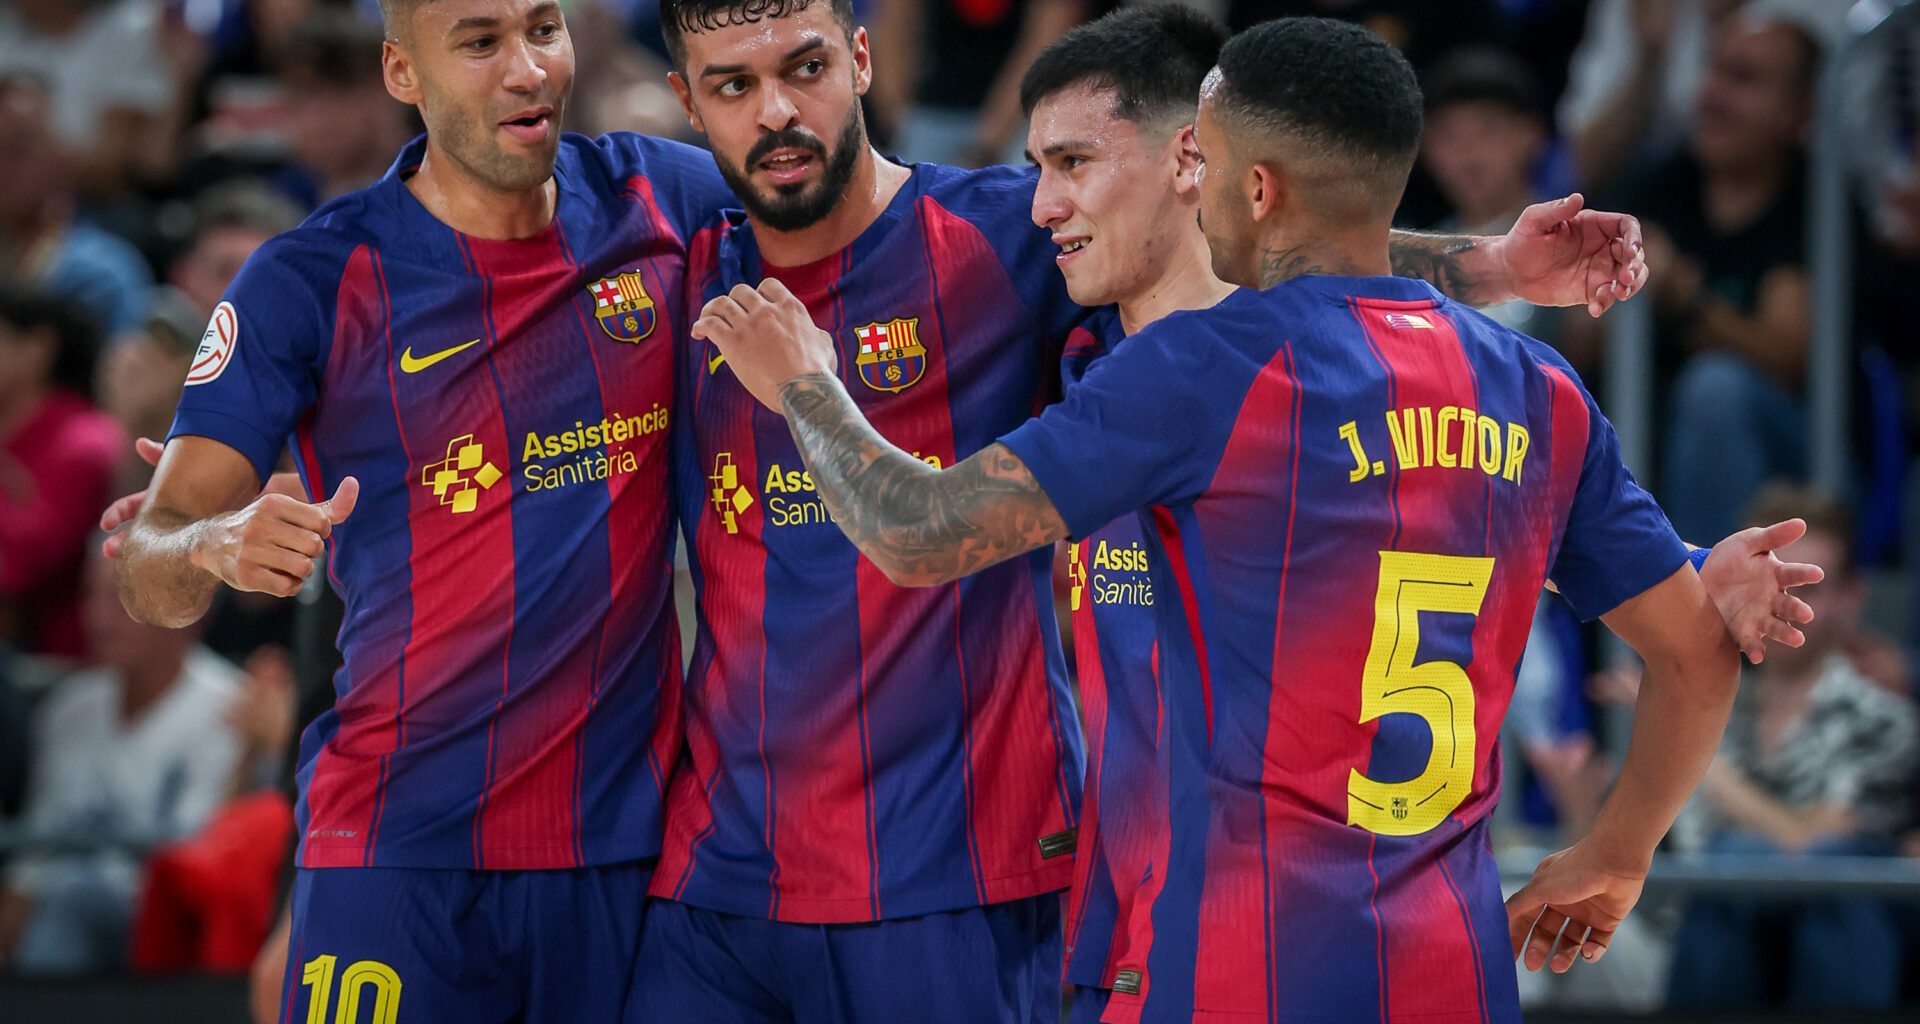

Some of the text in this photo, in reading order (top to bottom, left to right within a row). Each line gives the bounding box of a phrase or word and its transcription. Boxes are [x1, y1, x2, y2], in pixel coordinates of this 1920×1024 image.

[613, 300, 637, 313] FCB
[876, 348, 904, 361] FCB
[522, 403, 668, 463] Assistència
[524, 446, 638, 492] Sanitària
[769, 495, 837, 527] Sani
[1347, 550, 1496, 836] 5
[302, 953, 402, 1024] 10
